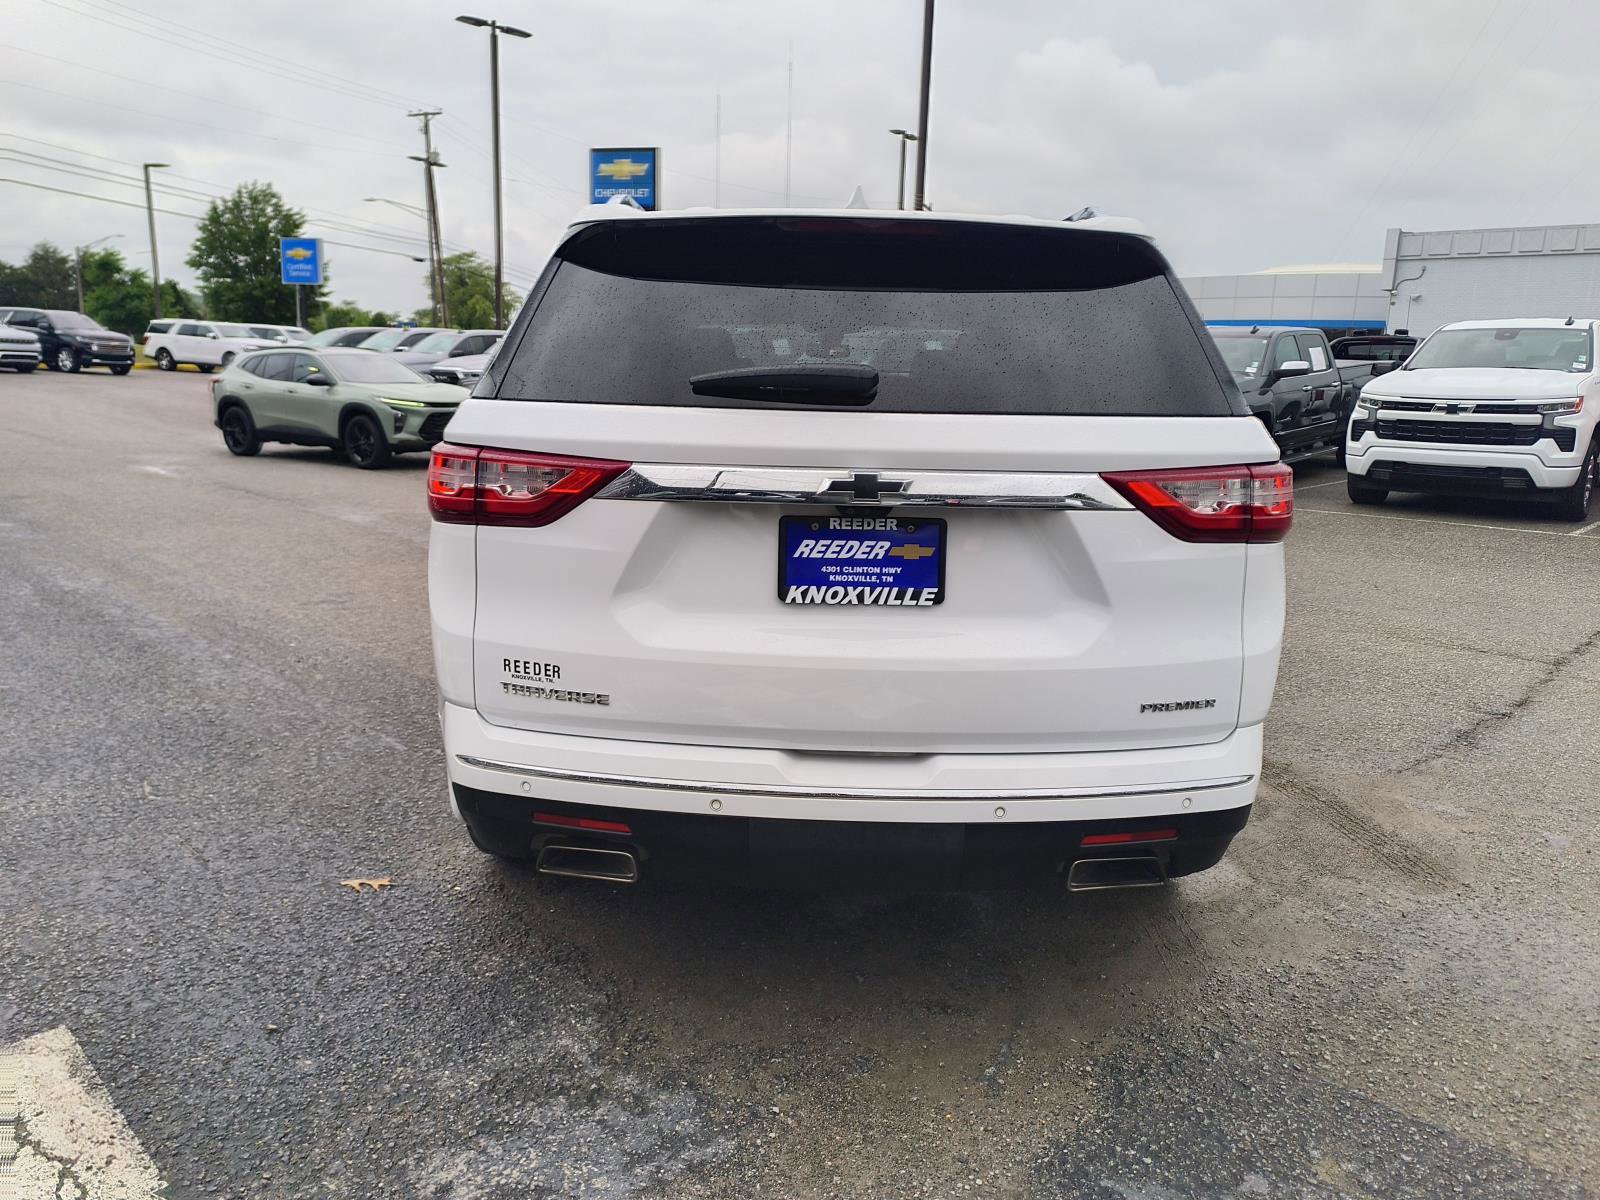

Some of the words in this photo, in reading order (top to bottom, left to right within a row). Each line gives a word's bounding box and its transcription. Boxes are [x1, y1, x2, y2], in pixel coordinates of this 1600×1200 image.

[830, 518, 898, 531] REEDER
[793, 539, 891, 560] REEDER
[829, 575, 880, 583] KNOXVILLE,
[785, 586, 939, 606] KNOXVILLE
[503, 658, 561, 679] REEDER
[512, 674, 544, 682] KNOXVILLE,
[500, 682, 610, 706] TRAVERSE
[1140, 698, 1216, 714] PREMIER
